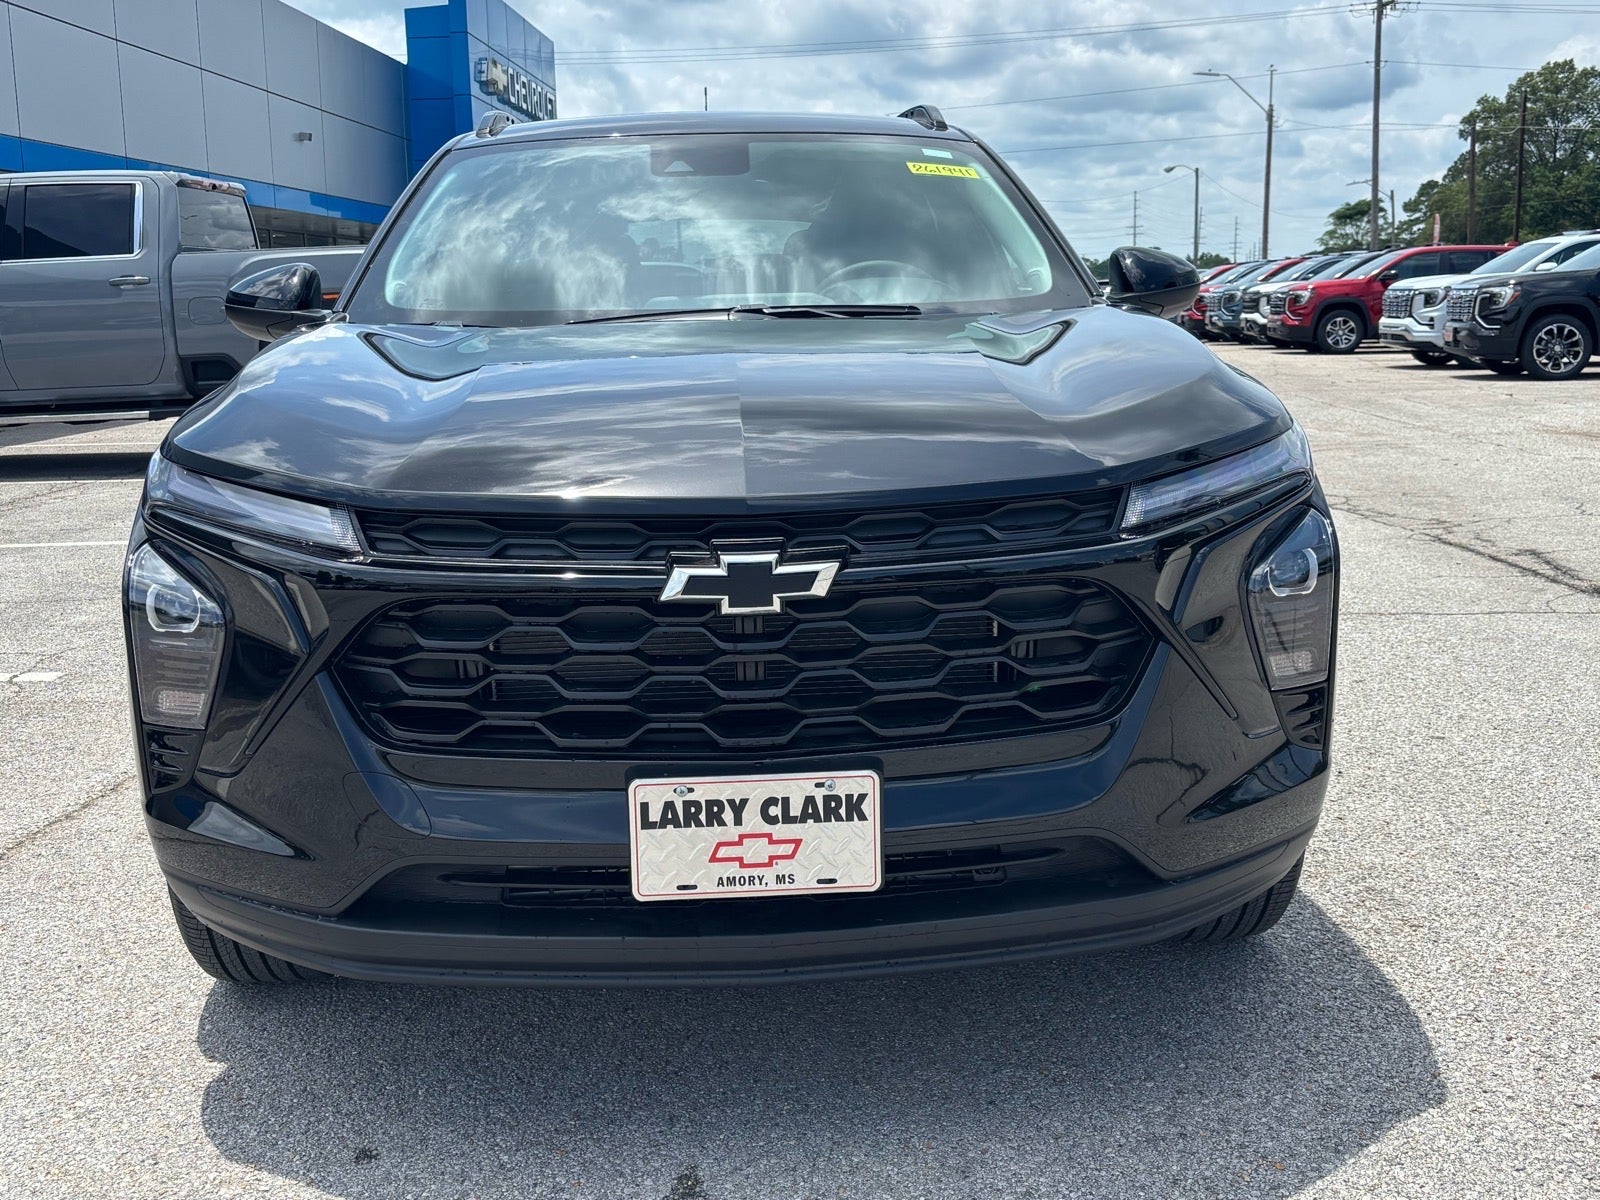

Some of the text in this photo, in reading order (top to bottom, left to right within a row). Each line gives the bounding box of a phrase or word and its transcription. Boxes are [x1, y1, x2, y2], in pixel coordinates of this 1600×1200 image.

[507, 66, 556, 120] CHEVROLET
[639, 793, 868, 830] LARRY CLARK
[716, 873, 795, 888] AMORY, MS
